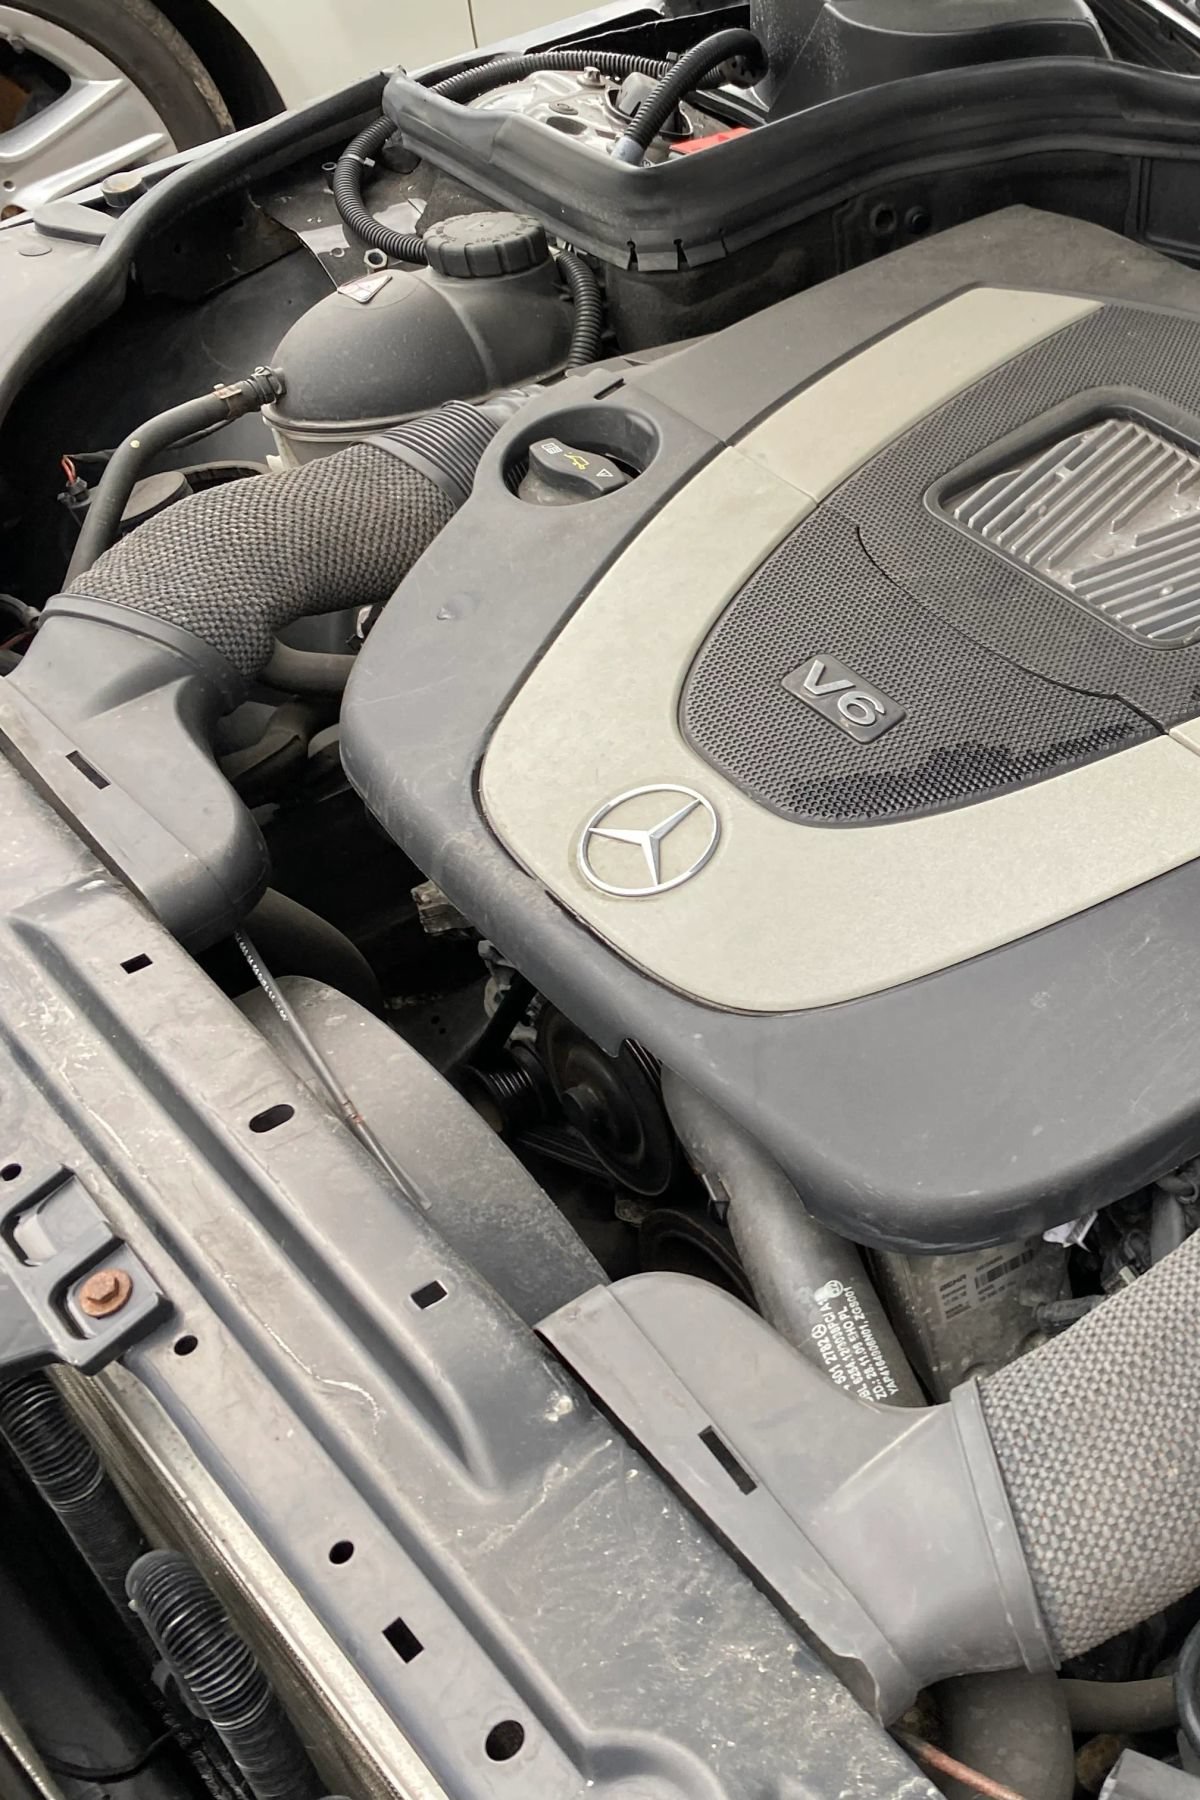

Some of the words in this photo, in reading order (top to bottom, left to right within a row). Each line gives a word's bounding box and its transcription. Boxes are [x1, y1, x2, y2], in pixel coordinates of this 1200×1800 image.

[803, 659, 885, 726] V6
[817, 1336, 838, 1365] 2782
[828, 1364, 847, 1385] 501
